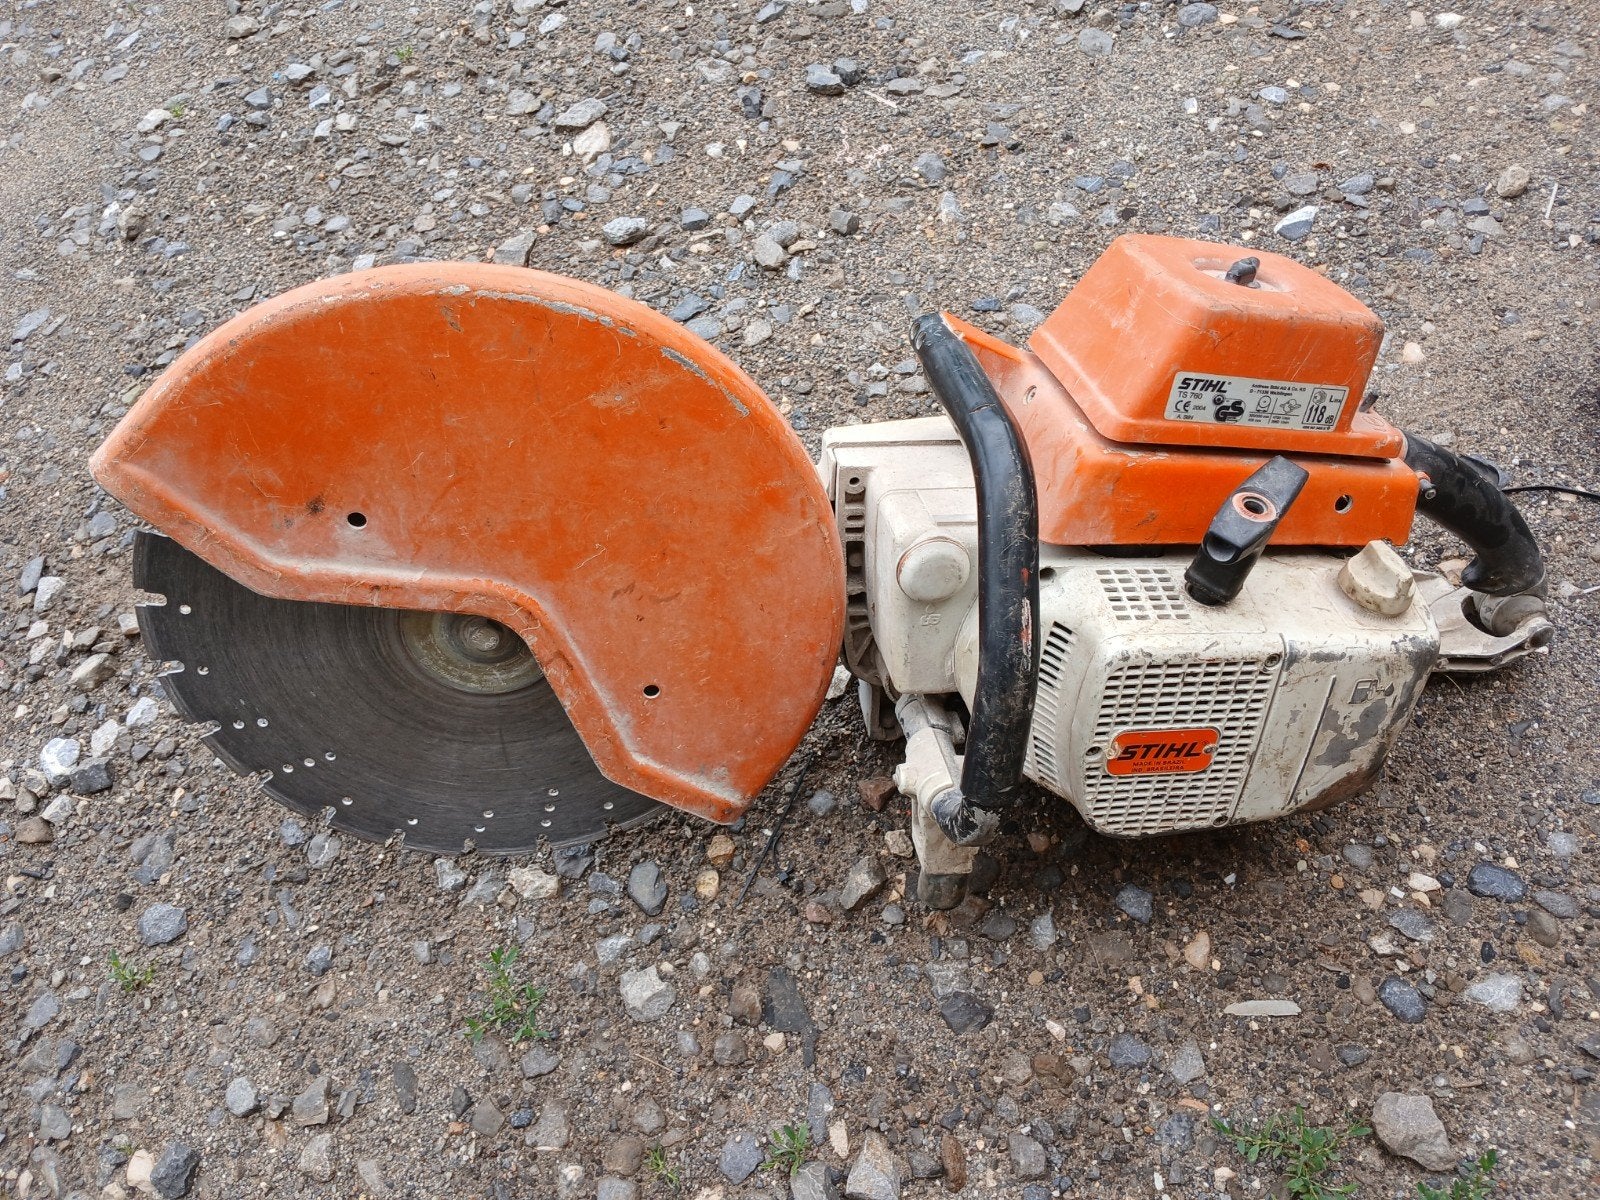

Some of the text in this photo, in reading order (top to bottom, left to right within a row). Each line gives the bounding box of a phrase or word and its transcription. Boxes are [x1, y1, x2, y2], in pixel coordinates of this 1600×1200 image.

[1178, 377, 1228, 393] STIHL
[1306, 405, 1327, 423] 118
[1325, 415, 1334, 424] dB
[1117, 742, 1201, 761] STIHL
